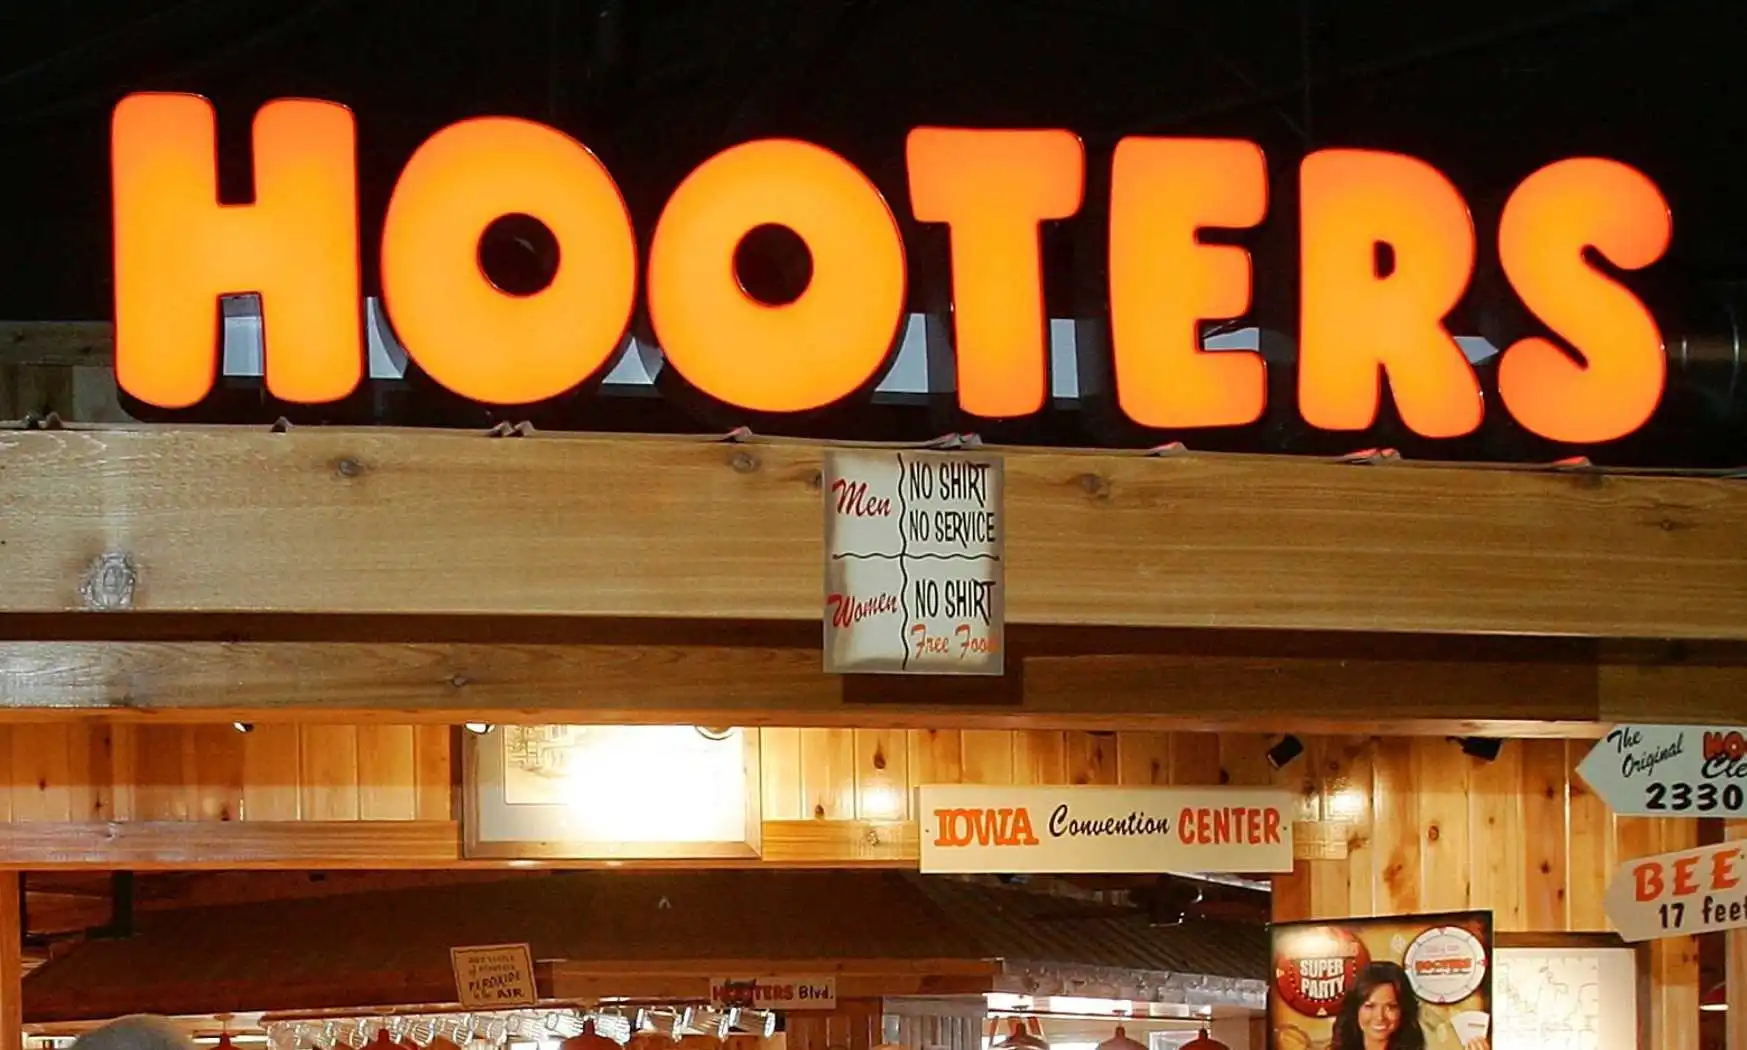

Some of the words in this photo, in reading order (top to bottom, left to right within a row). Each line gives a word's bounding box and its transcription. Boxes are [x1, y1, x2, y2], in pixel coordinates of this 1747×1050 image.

[110, 91, 1673, 444] HOOTERS
[831, 478, 892, 518] Men
[909, 461, 933, 501] NO
[939, 460, 991, 508] SHIRT
[909, 510, 930, 542] NO
[935, 511, 996, 549] SERVICE
[826, 592, 899, 629] Women
[915, 580, 939, 619] NO
[944, 578, 997, 626] SHIRT
[911, 624, 949, 659] Free
[1607, 726, 1643, 754] The
[1621, 732, 1684, 778] Original
[1645, 782, 1744, 811] 2330
[934, 807, 1039, 847] IOWA
[1049, 803, 1170, 837] Convention
[1178, 806, 1281, 845] CENTER
[1659, 902, 1685, 929] 17
[1299, 957, 1344, 979] SUPER
[1300, 974, 1345, 999] PARTY
[798, 984, 834, 1000] Blvd.
